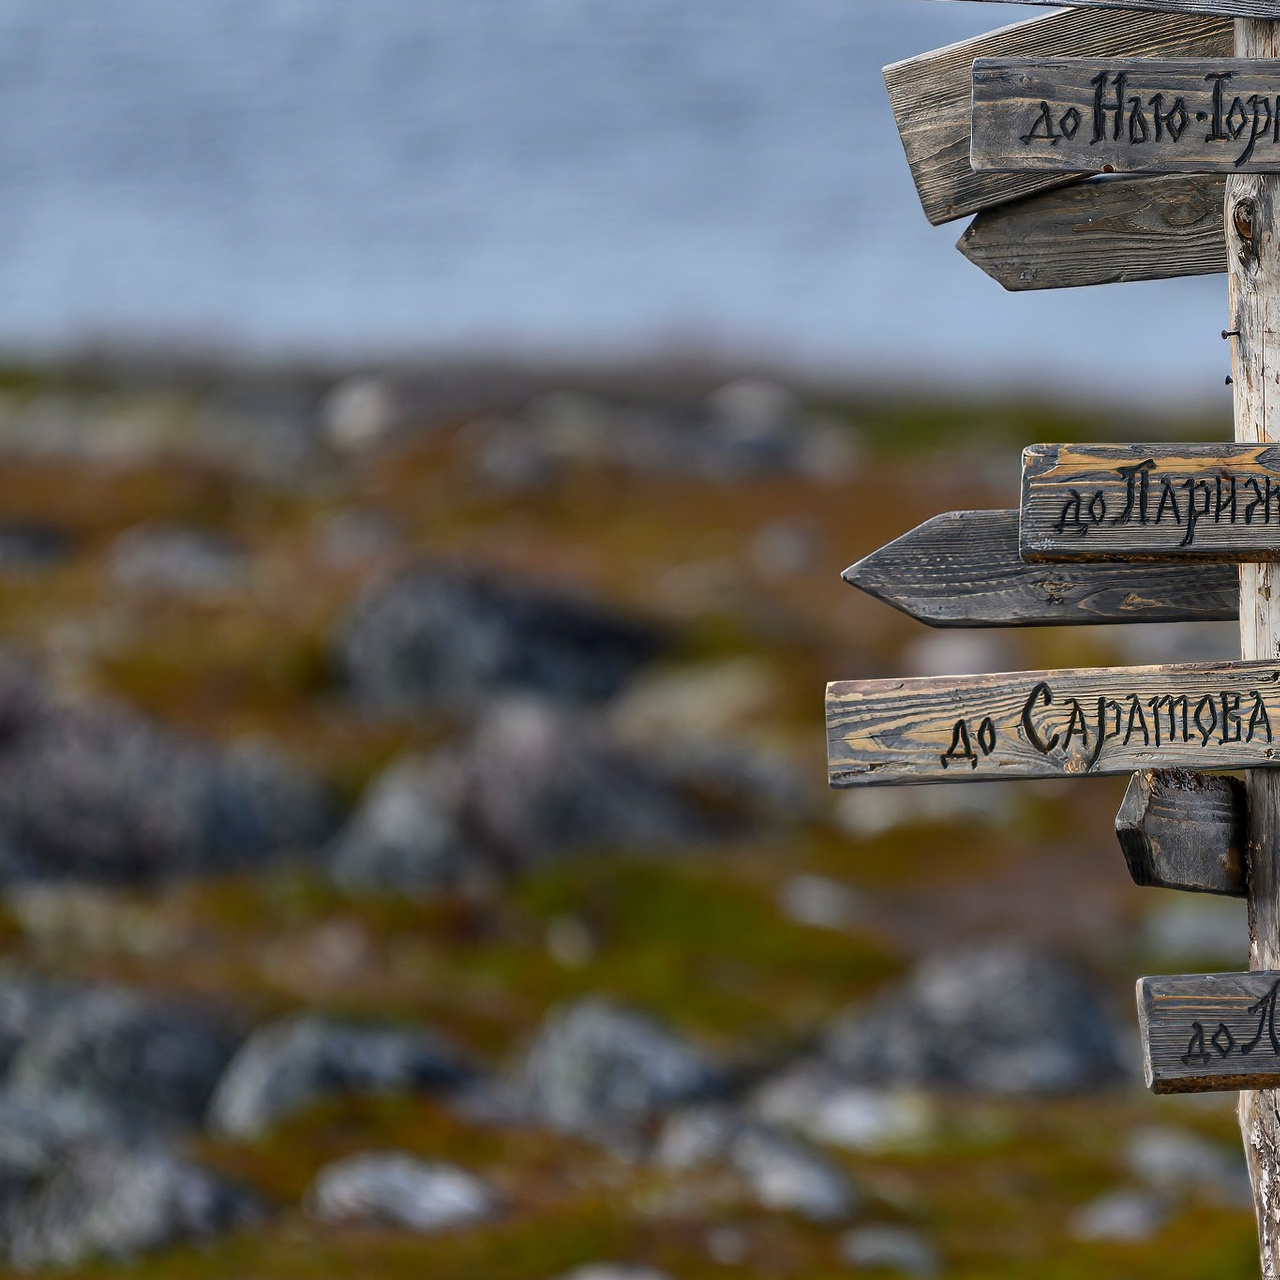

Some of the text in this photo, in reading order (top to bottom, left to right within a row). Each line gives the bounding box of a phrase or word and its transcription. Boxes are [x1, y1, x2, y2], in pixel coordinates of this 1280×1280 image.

[1020, 100, 1081, 145] до
[1054, 488, 1106, 536] до
[940, 717, 997, 770] до
[1020, 681, 1273, 773] Саратова
[1181, 1021, 1236, 1066] до
